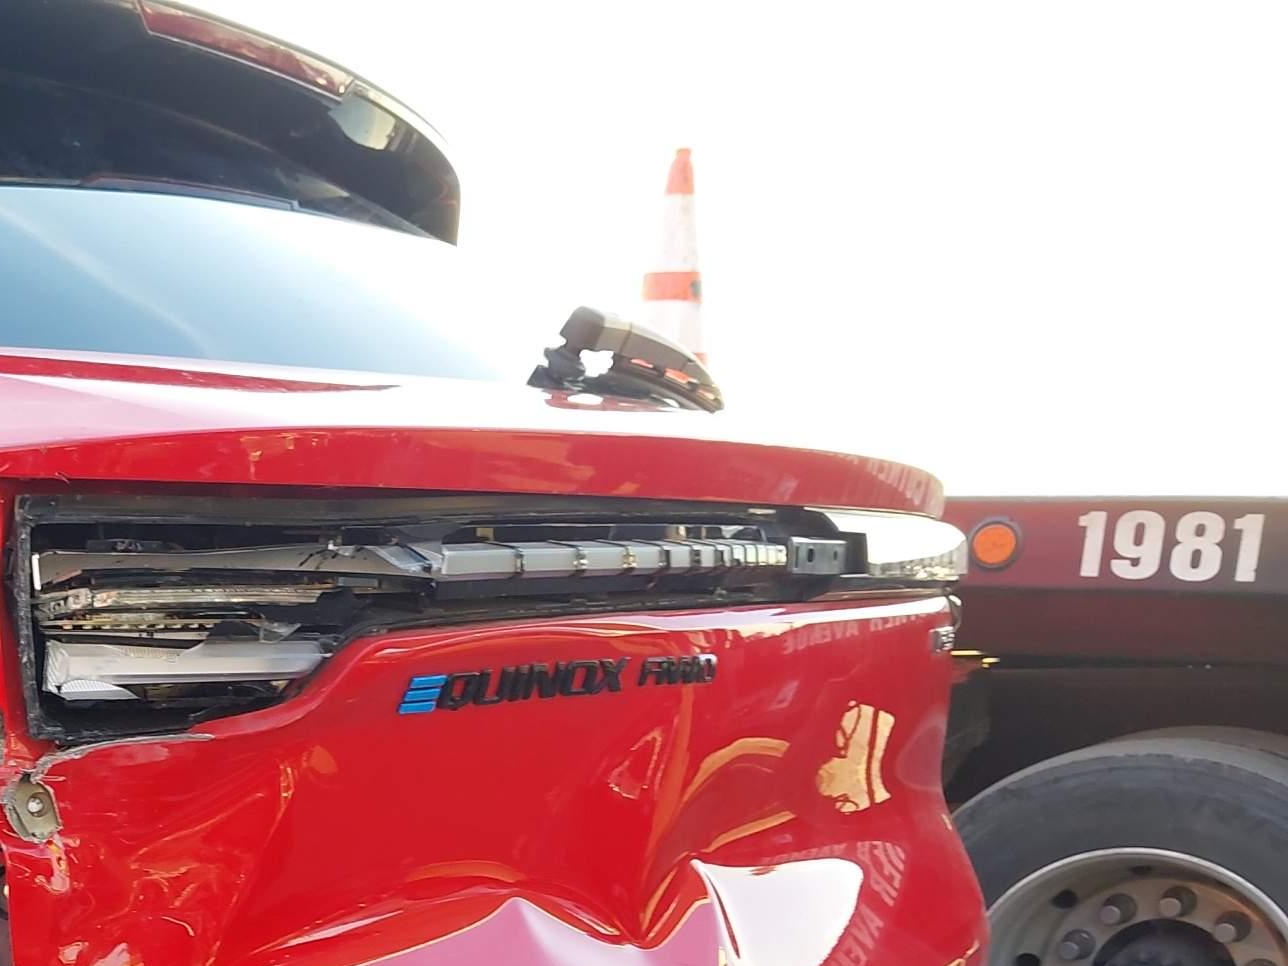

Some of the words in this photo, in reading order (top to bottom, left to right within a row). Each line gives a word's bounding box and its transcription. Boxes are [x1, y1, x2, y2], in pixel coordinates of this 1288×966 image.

[1078, 509, 1265, 583] 1981
[397, 657, 630, 714] EQUINOX
[637, 653, 717, 686] AWD
